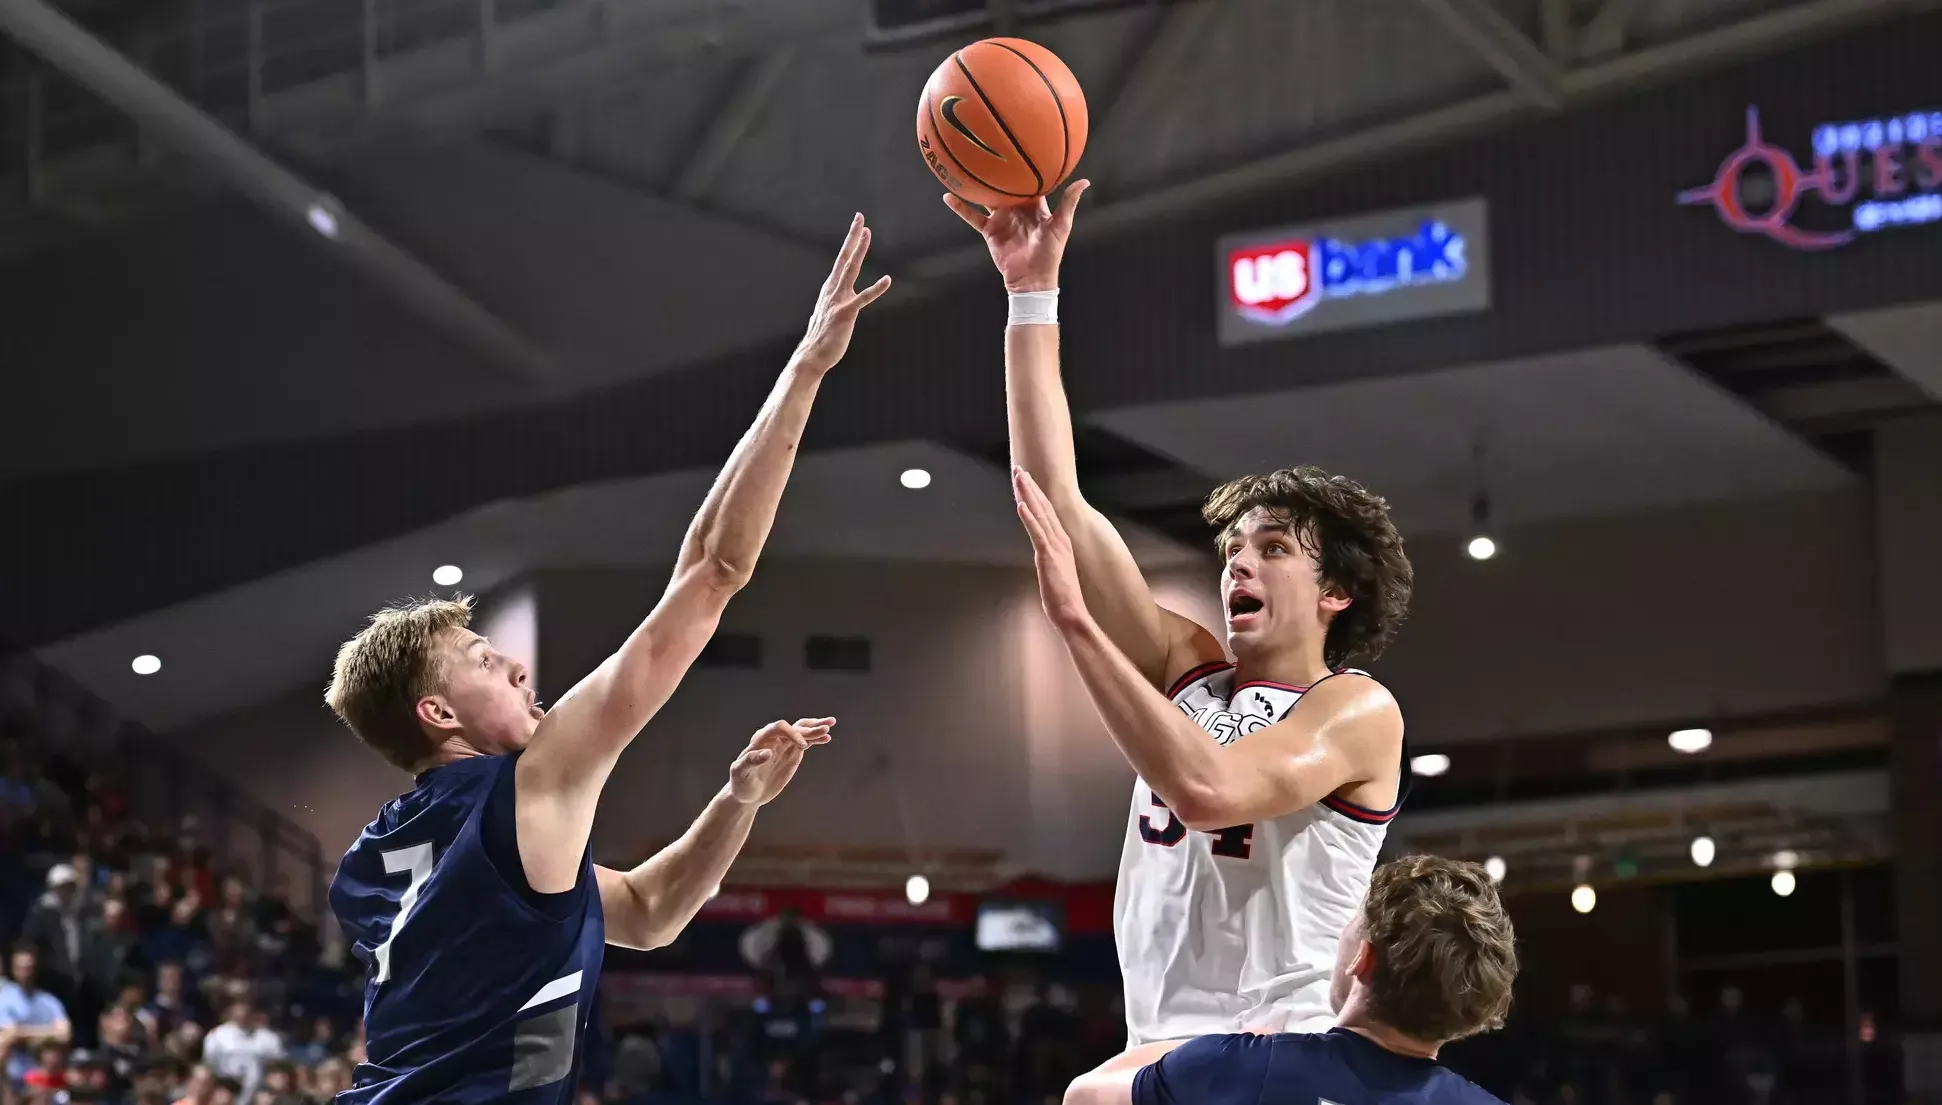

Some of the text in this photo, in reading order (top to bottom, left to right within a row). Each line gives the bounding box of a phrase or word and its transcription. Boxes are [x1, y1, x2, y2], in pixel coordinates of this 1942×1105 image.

[1317, 218, 1468, 298] bank
[1178, 700, 1272, 746] AGS
[374, 840, 435, 984] 7
